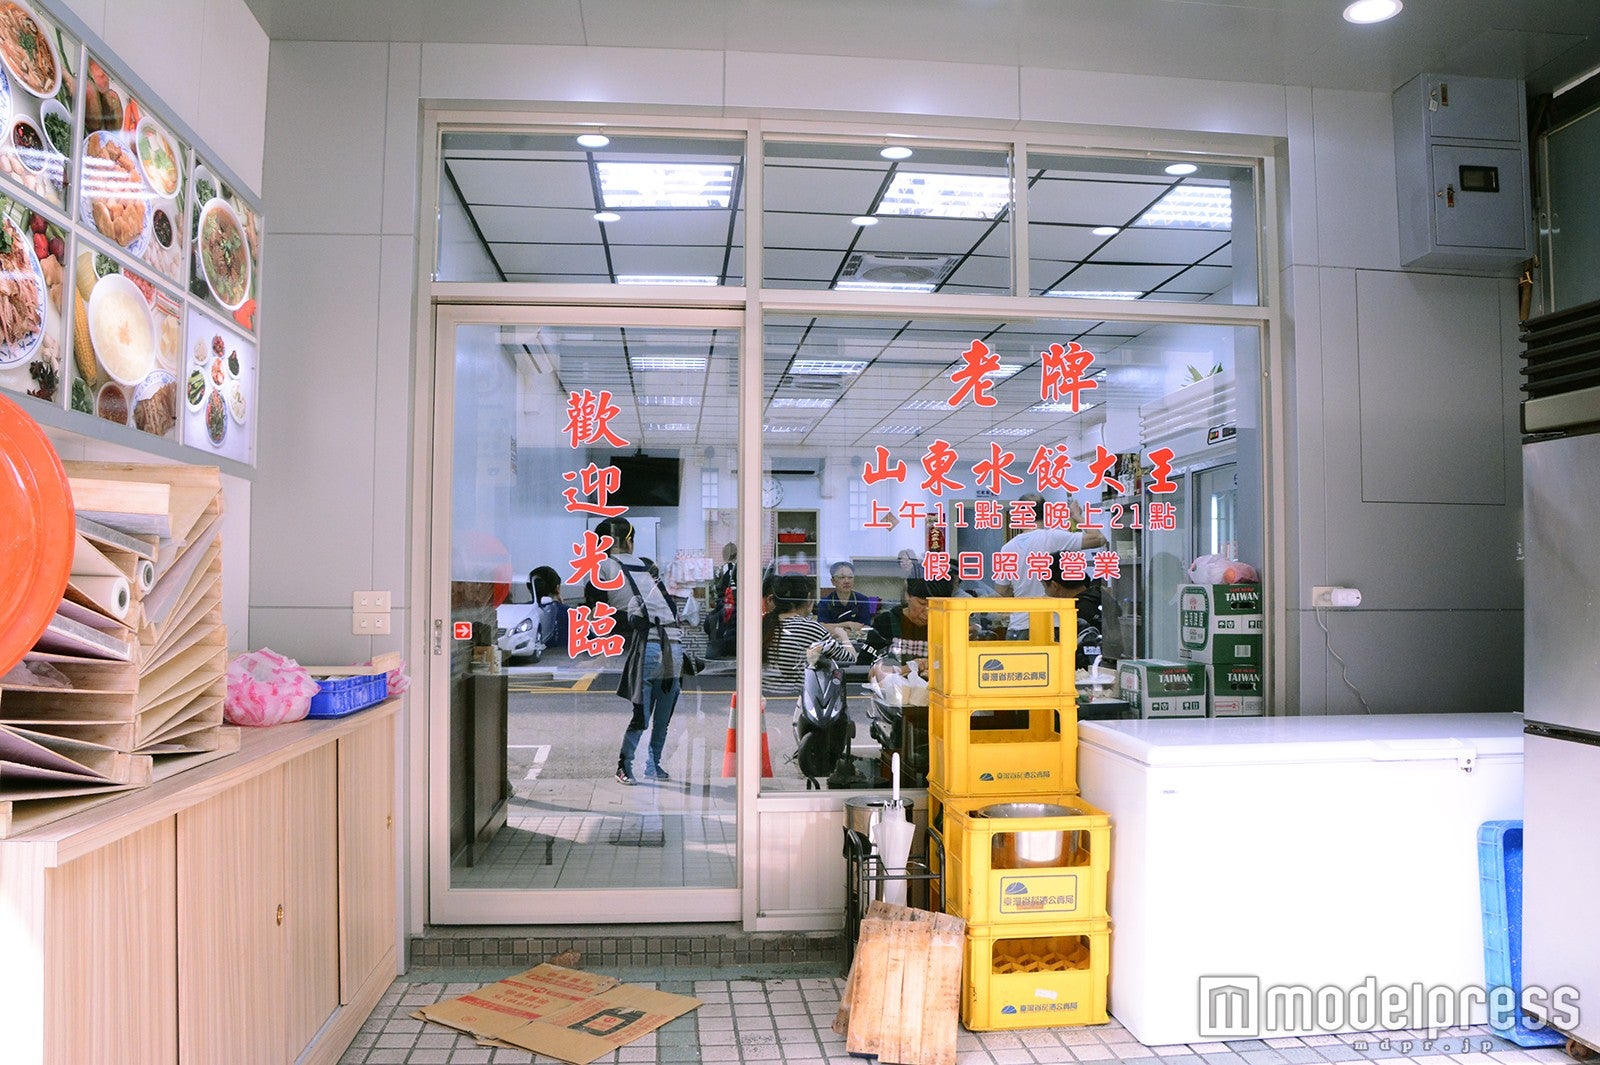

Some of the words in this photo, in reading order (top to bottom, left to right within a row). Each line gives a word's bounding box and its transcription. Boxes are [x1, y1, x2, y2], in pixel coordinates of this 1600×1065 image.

[948, 339, 1098, 413] 老牌
[862, 439, 1178, 497] 山東水餃大王
[562, 388, 630, 659] 歡迎光臨
[863, 500, 1177, 531] 上午11點至晚上21點
[922, 552, 1121, 581] 假日照常營業
[1225, 592, 1259, 602] TAIWAN
[1159, 673, 1193, 683] TAIWAN
[1227, 673, 1260, 682] TAIWAN
